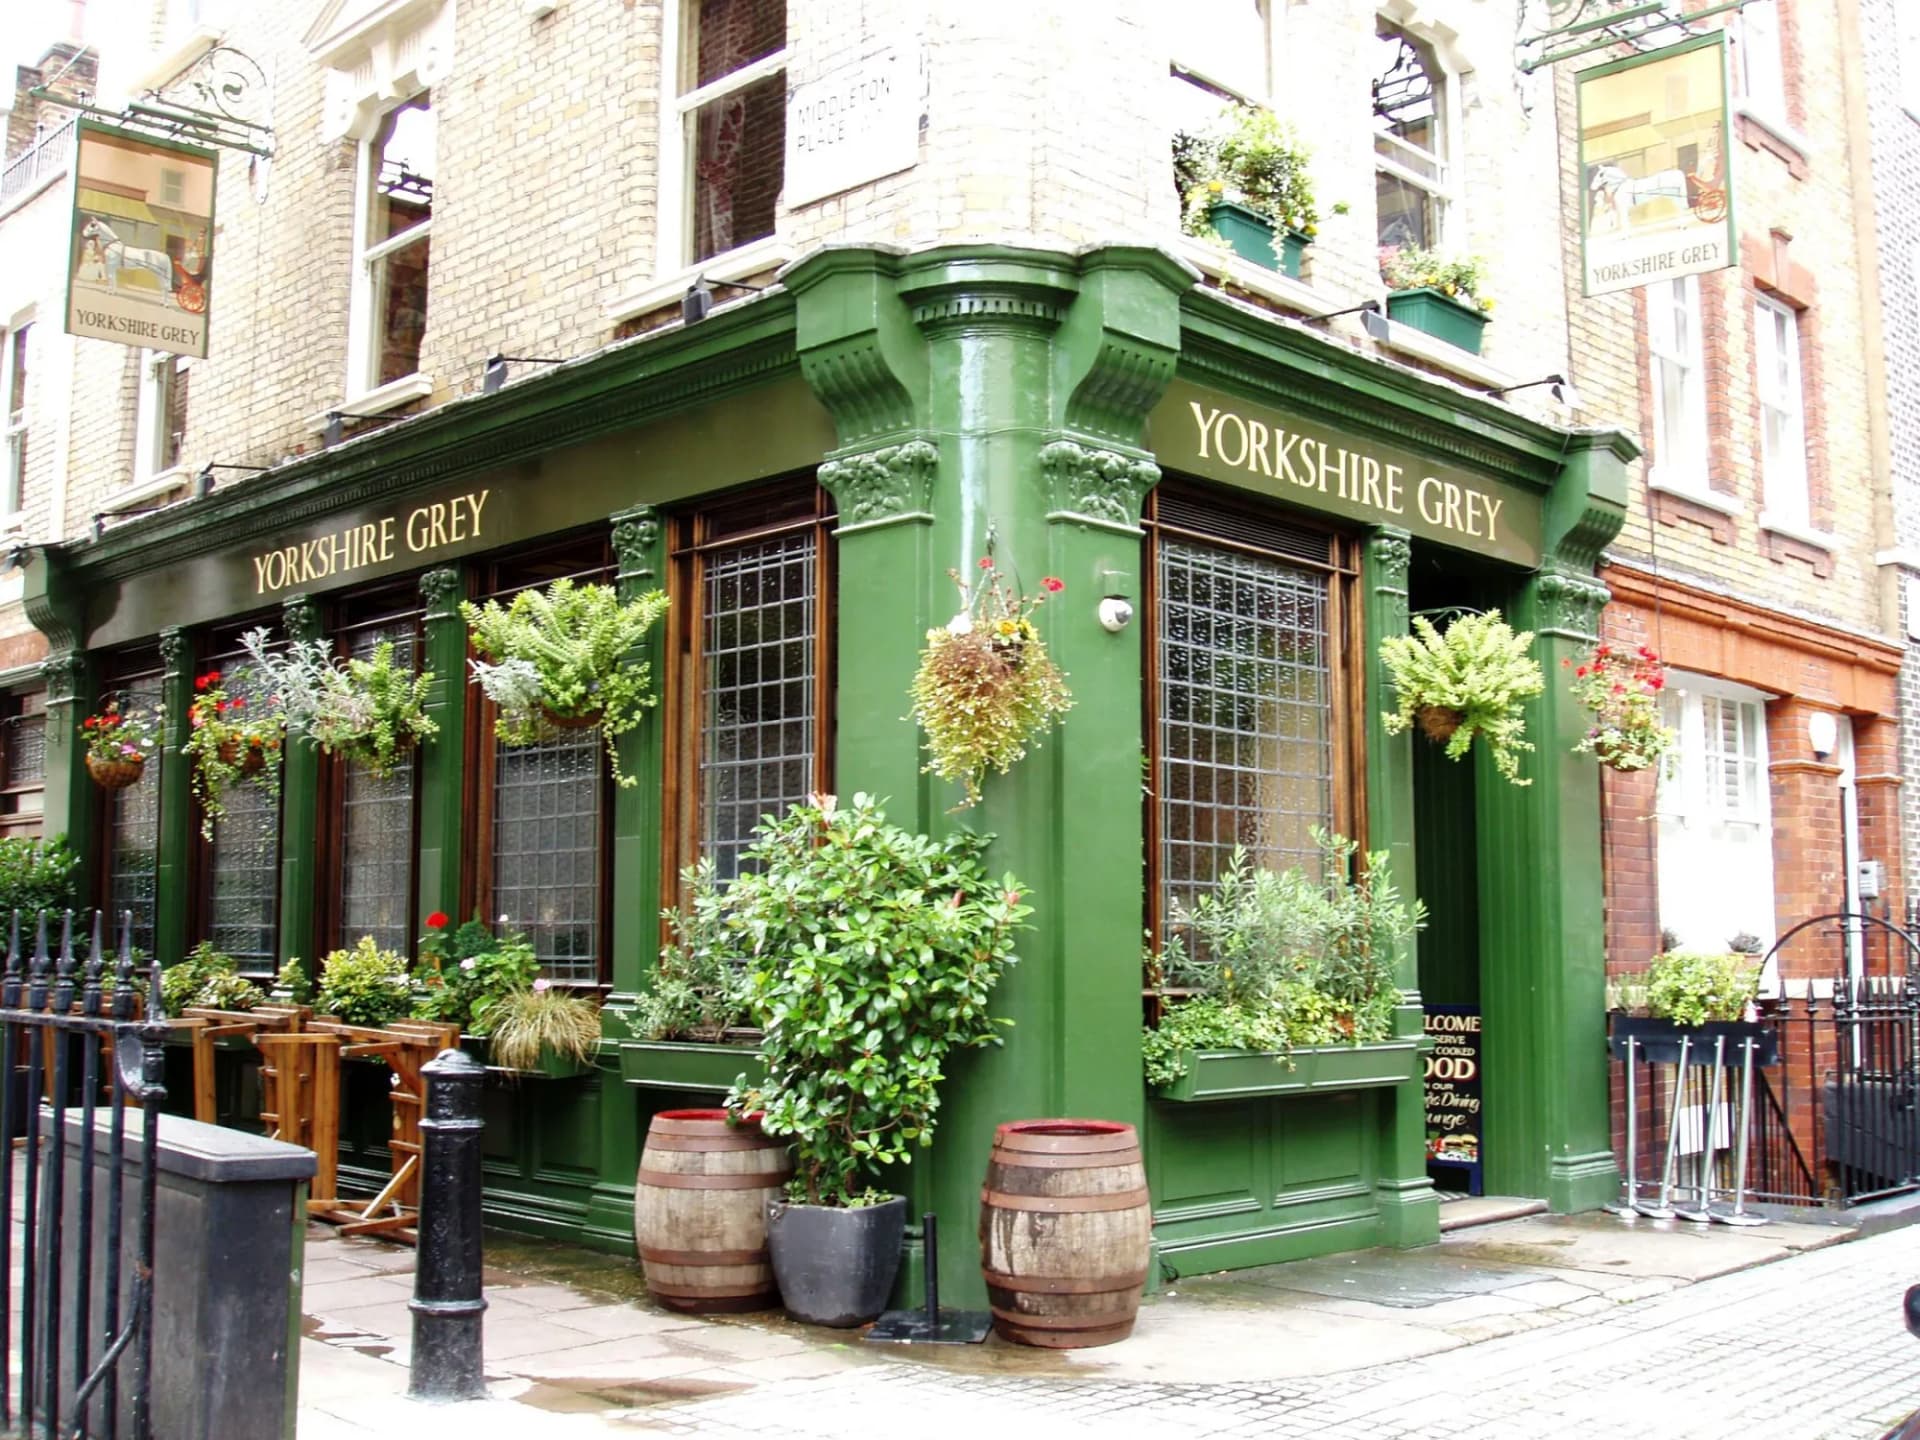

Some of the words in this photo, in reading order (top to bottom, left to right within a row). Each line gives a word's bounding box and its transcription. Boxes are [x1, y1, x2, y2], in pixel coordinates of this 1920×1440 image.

[1592, 251, 1676, 285] YORKSHIRE
[1681, 242, 1722, 265] GREY
[76, 308, 159, 338] YORKSHIRE
[161, 325, 200, 345] GREY
[1189, 401, 1404, 515] YORKSHIRE
[1417, 477, 1504, 541] GREY
[253, 517, 396, 594] YORKSHIRE
[406, 489, 490, 552] GREY
[1423, 1014, 1482, 1032] LCOME
[1435, 1046, 1476, 1057] COOKED
[1423, 1057, 1476, 1079] OOD
[1441, 1091, 1480, 1114] Dining
[1426, 1113, 1466, 1131] unge
